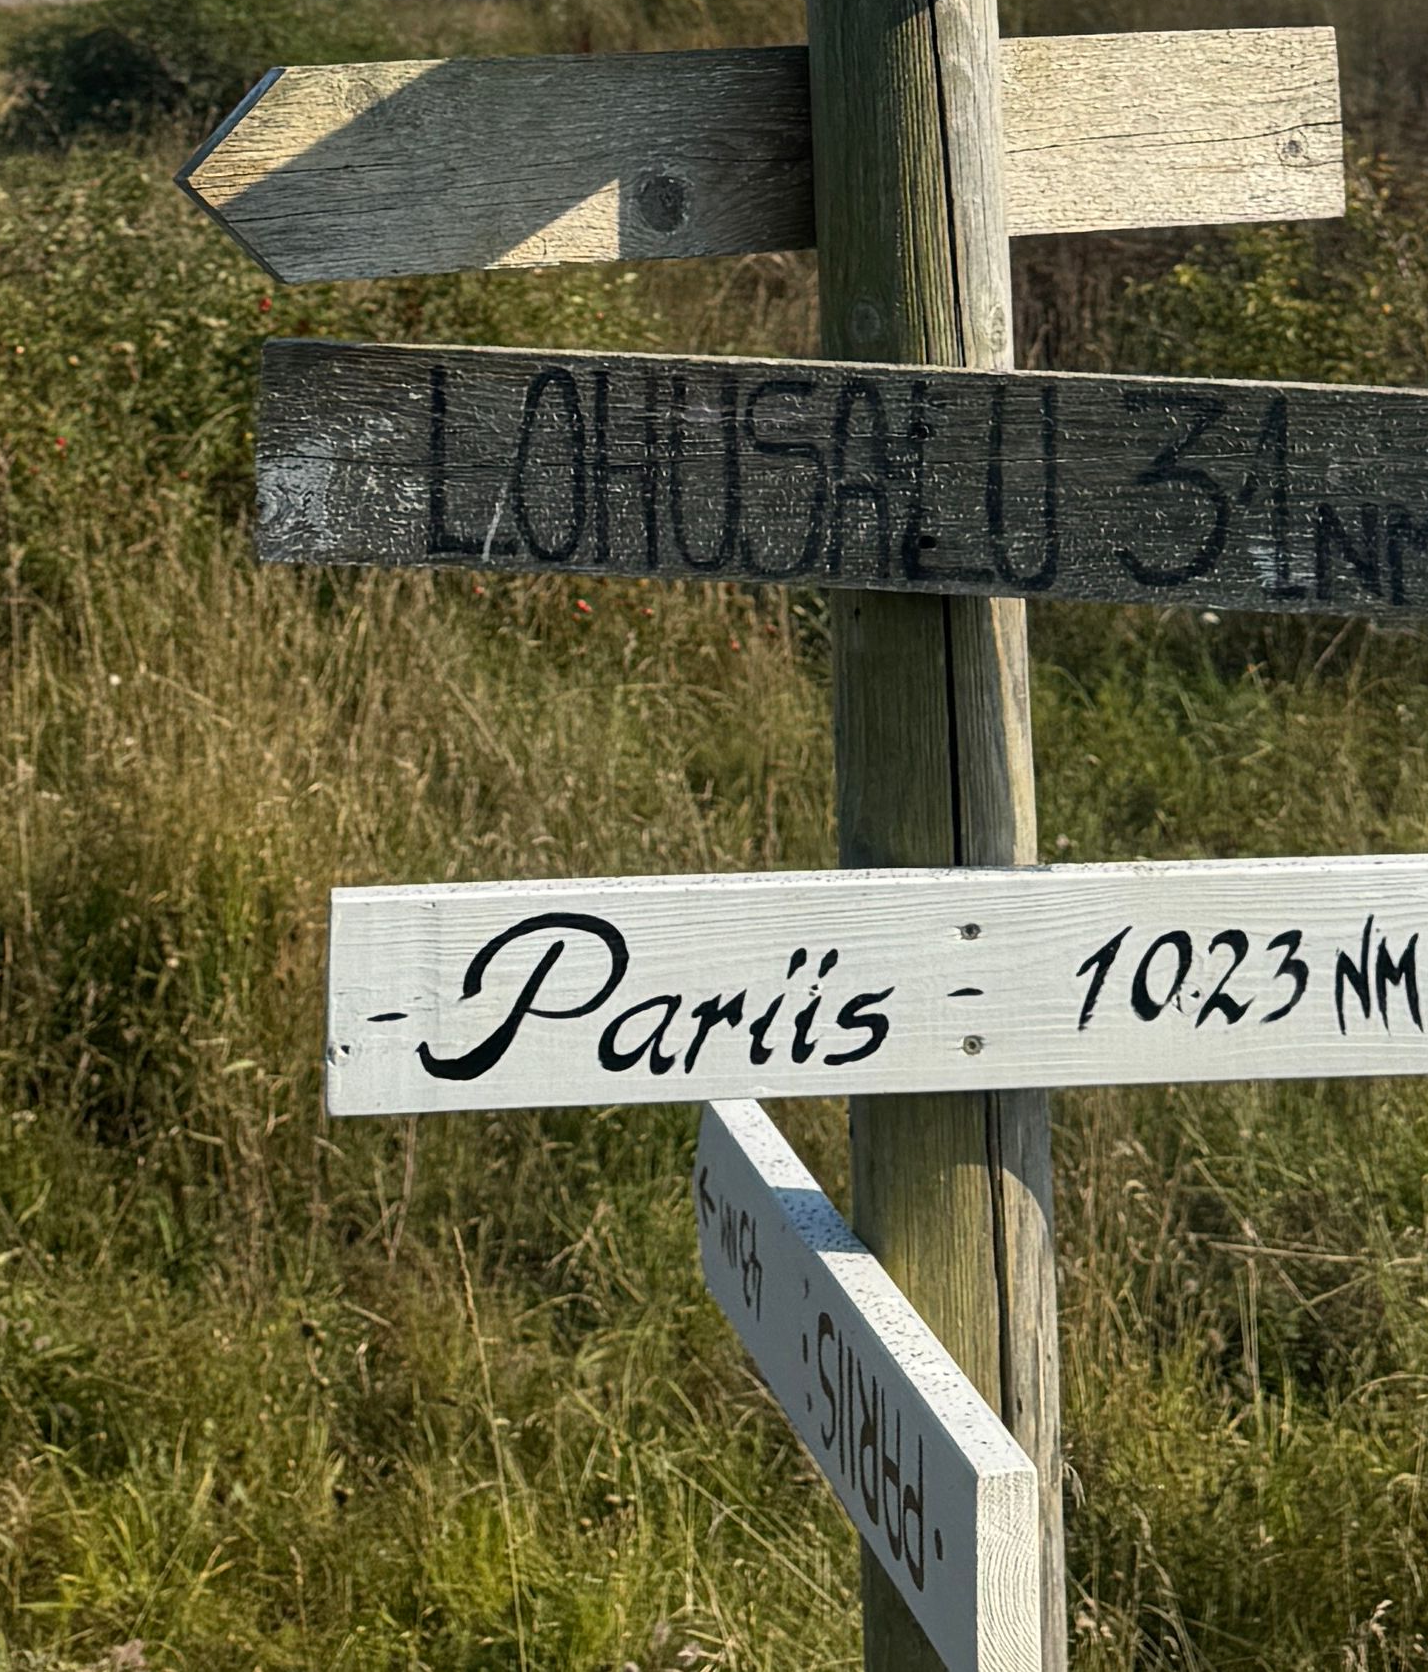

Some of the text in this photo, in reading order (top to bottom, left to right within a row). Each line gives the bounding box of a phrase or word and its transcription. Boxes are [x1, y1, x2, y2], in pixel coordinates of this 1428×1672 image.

[425, 363, 1061, 589] LOHUSALU
[415, 911, 896, 1081] Pariis
[1075, 925, 1310, 1032] 1023
